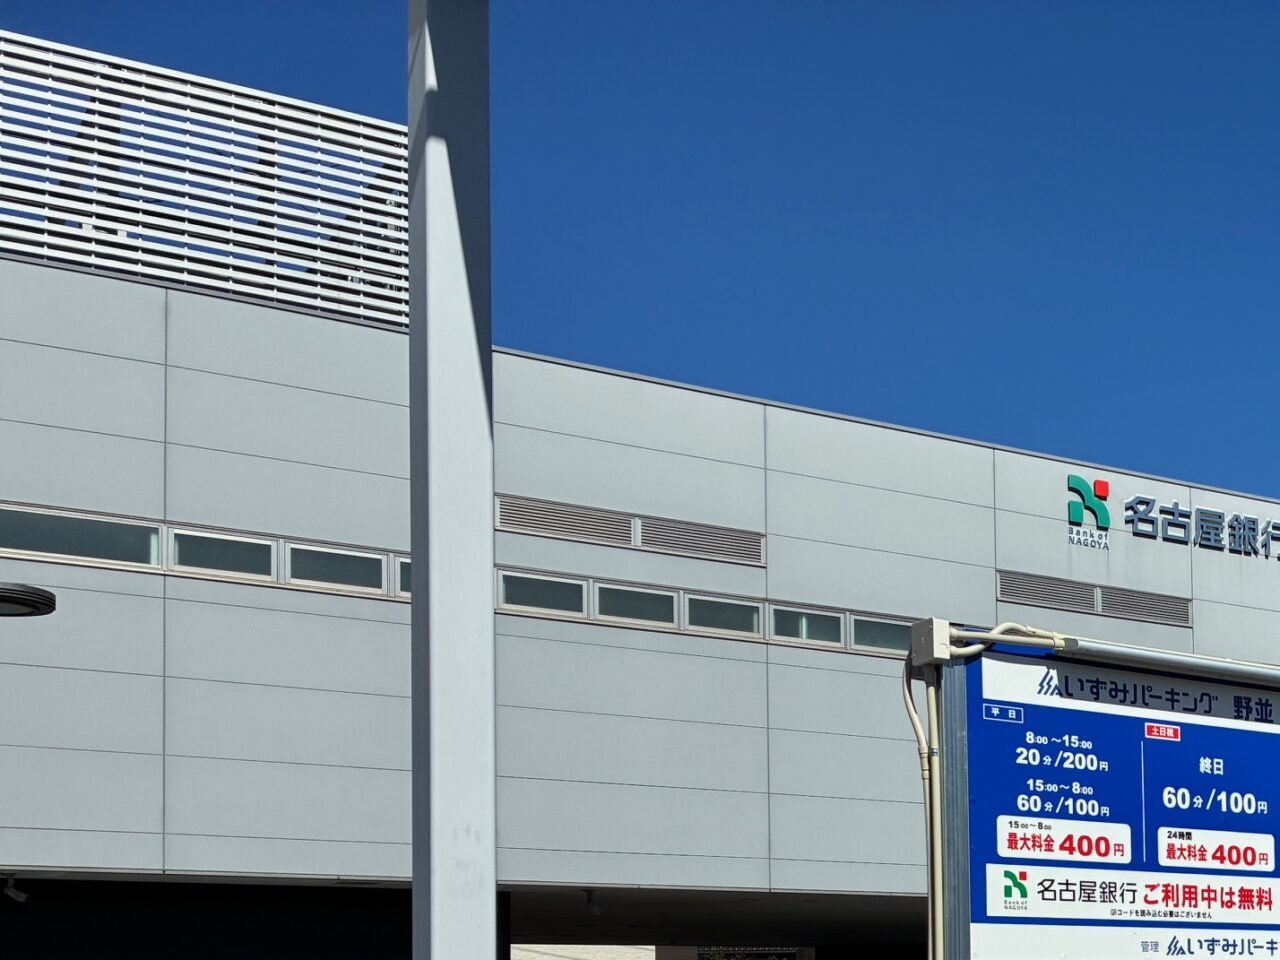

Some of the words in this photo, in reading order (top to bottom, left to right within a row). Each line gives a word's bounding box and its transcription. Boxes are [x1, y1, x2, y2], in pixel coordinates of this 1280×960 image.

[1068, 526, 1095, 539] Bank
[1097, 532, 1108, 541] of
[1068, 535, 1110, 551] NAGOYA
[1063, 674, 1219, 714] いずみパーキング
[1233, 694, 1275, 724] 野並
[990, 706, 1017, 719] 平日
[1151, 725, 1175, 737] 土日祝
[1199, 756, 1224, 776] 終日
[1006, 832, 1055, 853] 最大料金
[1165, 843, 1208, 862] 最大料金
[1036, 878, 1138, 905] 名古屋銀行
[1143, 883, 1273, 912] ご利用中は無料
[1140, 941, 1160, 953] 管理
